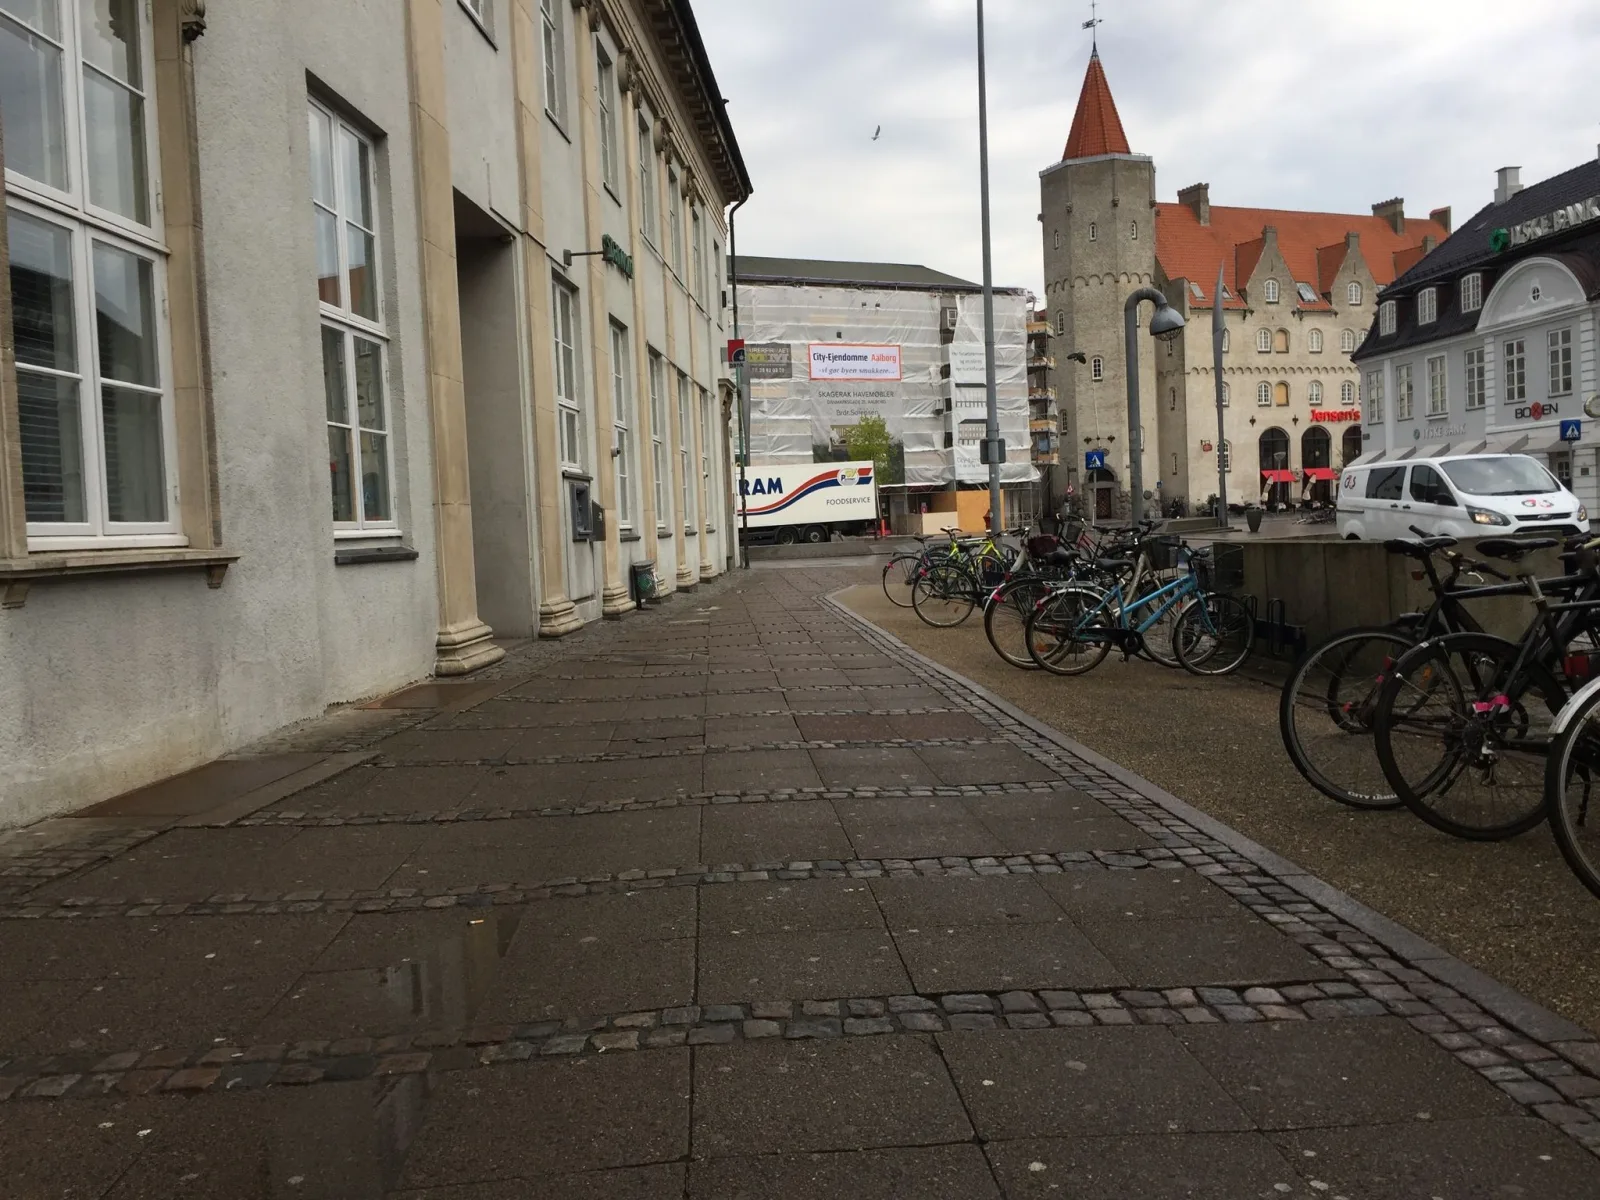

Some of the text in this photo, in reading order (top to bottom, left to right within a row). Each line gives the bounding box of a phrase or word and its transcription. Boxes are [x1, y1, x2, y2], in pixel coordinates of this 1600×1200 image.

[813, 353, 897, 363] City-Ejendomme Aalborg
[841, 367, 857, 375] byen
[1310, 408, 1361, 422] Jensen's
[826, 496, 871, 505] FOODSERVICE
